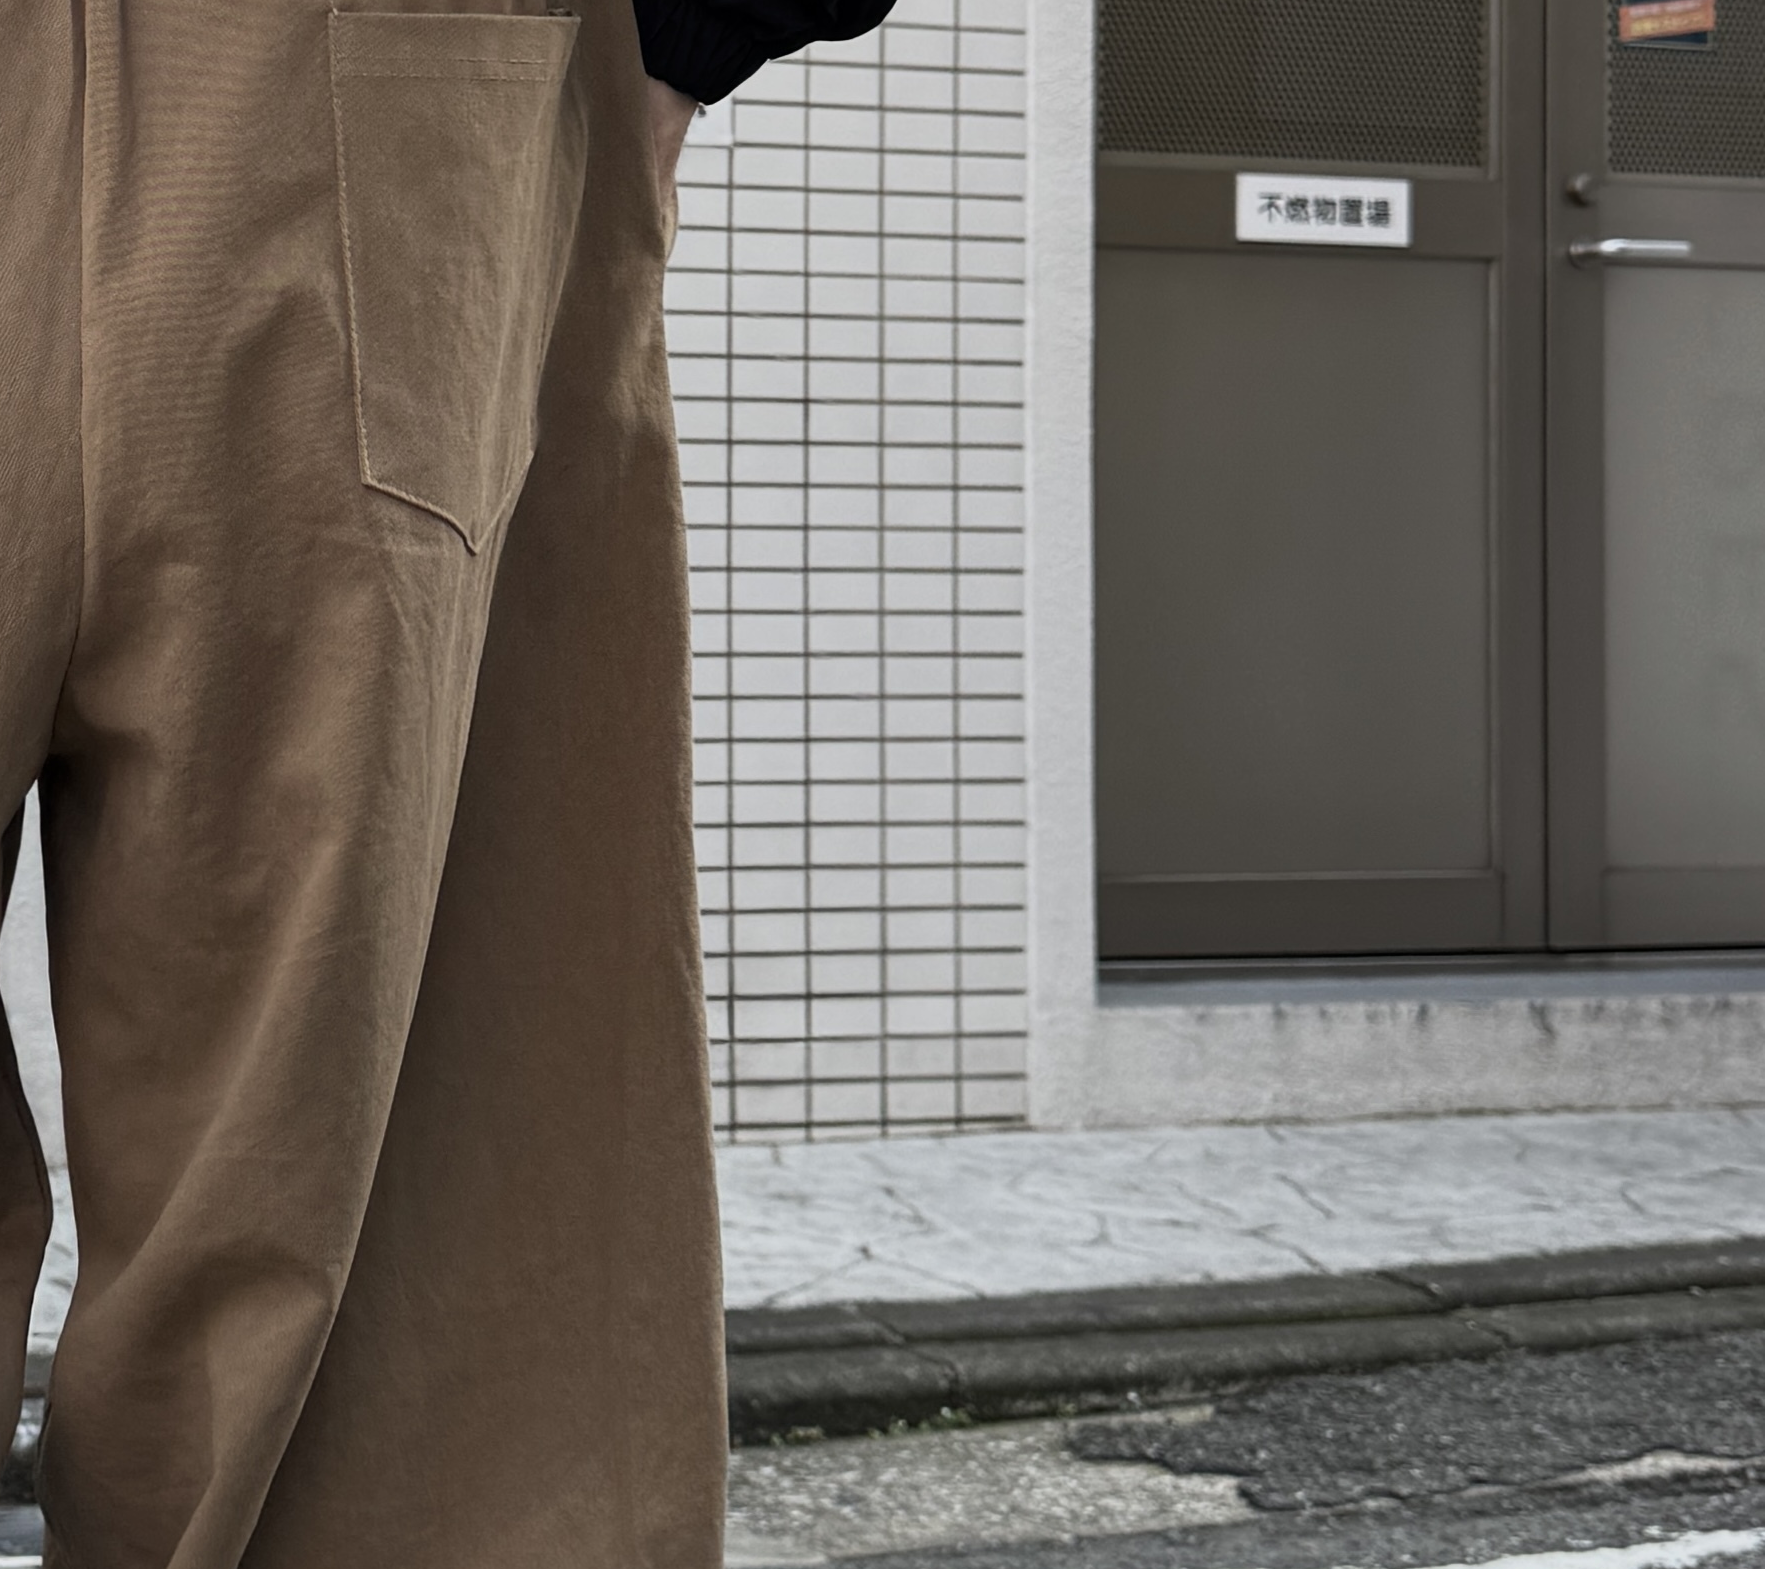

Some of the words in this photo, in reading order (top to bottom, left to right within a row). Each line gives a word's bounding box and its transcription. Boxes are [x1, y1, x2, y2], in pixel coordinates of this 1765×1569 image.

[1258, 191, 1390, 229] 不燃物置場
